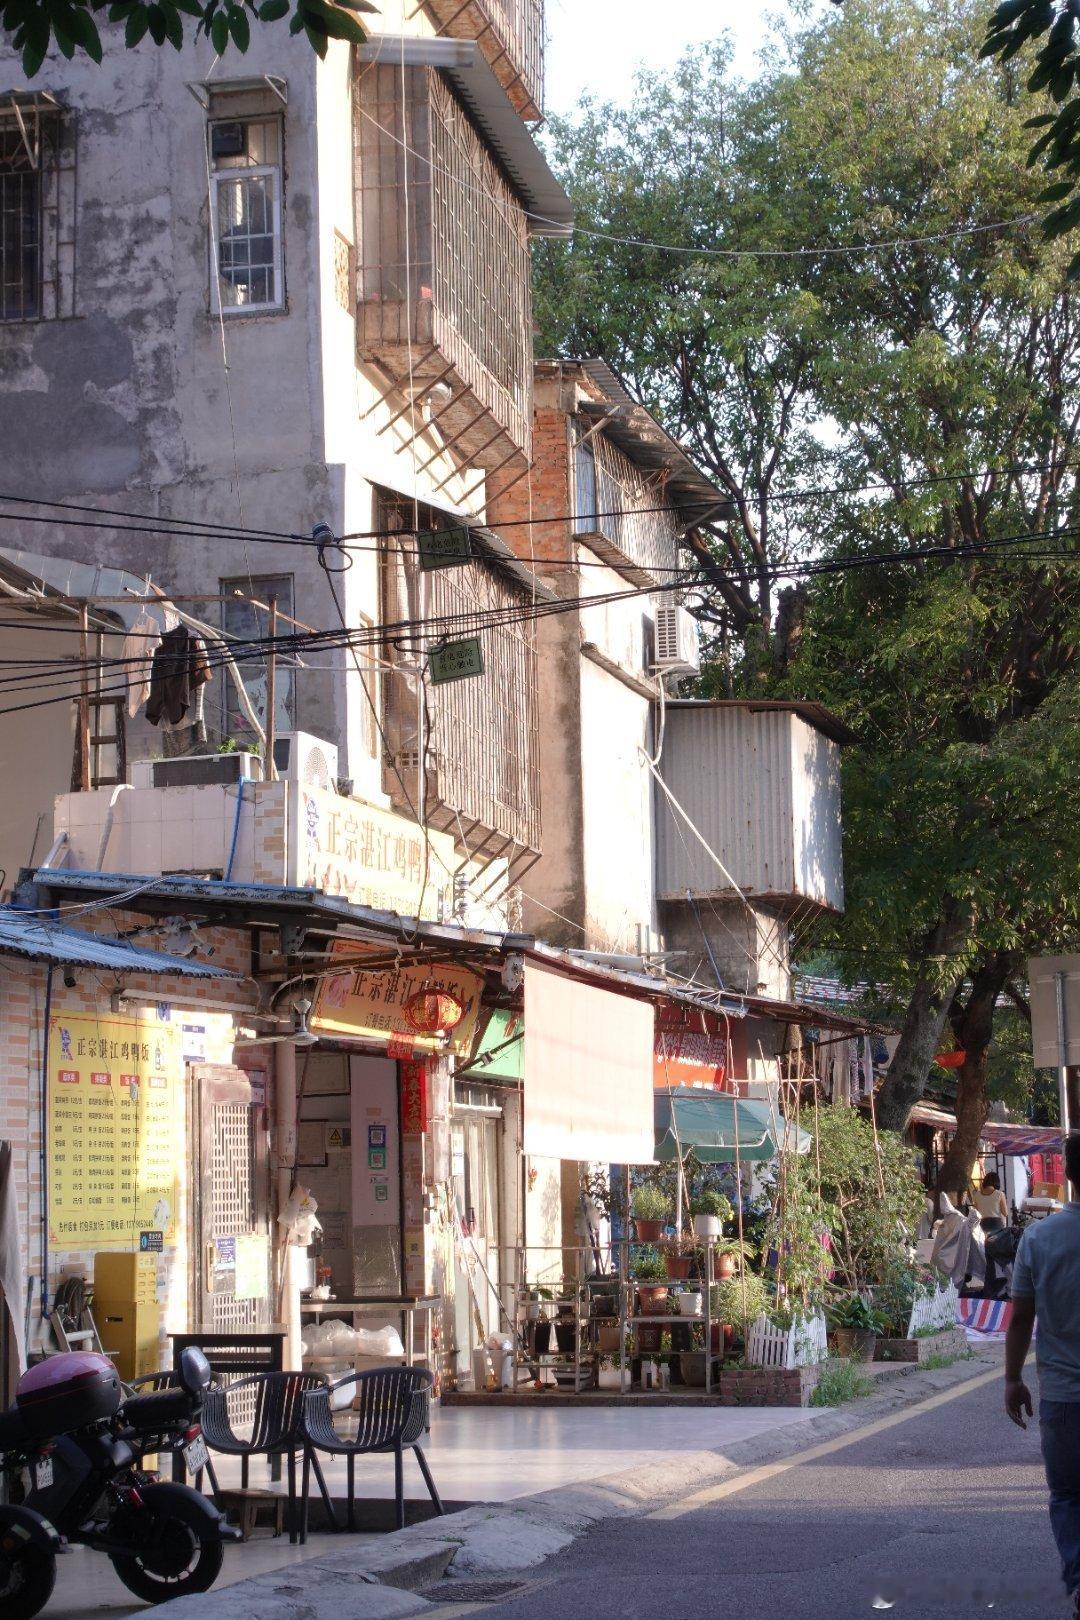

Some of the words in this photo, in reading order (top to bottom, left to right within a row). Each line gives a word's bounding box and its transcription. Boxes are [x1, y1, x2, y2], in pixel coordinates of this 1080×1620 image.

[328, 811, 431, 885] 正宗湛江鸡鸭
[77, 1037, 150, 1062] 正宗湛江鸡鸭饭
